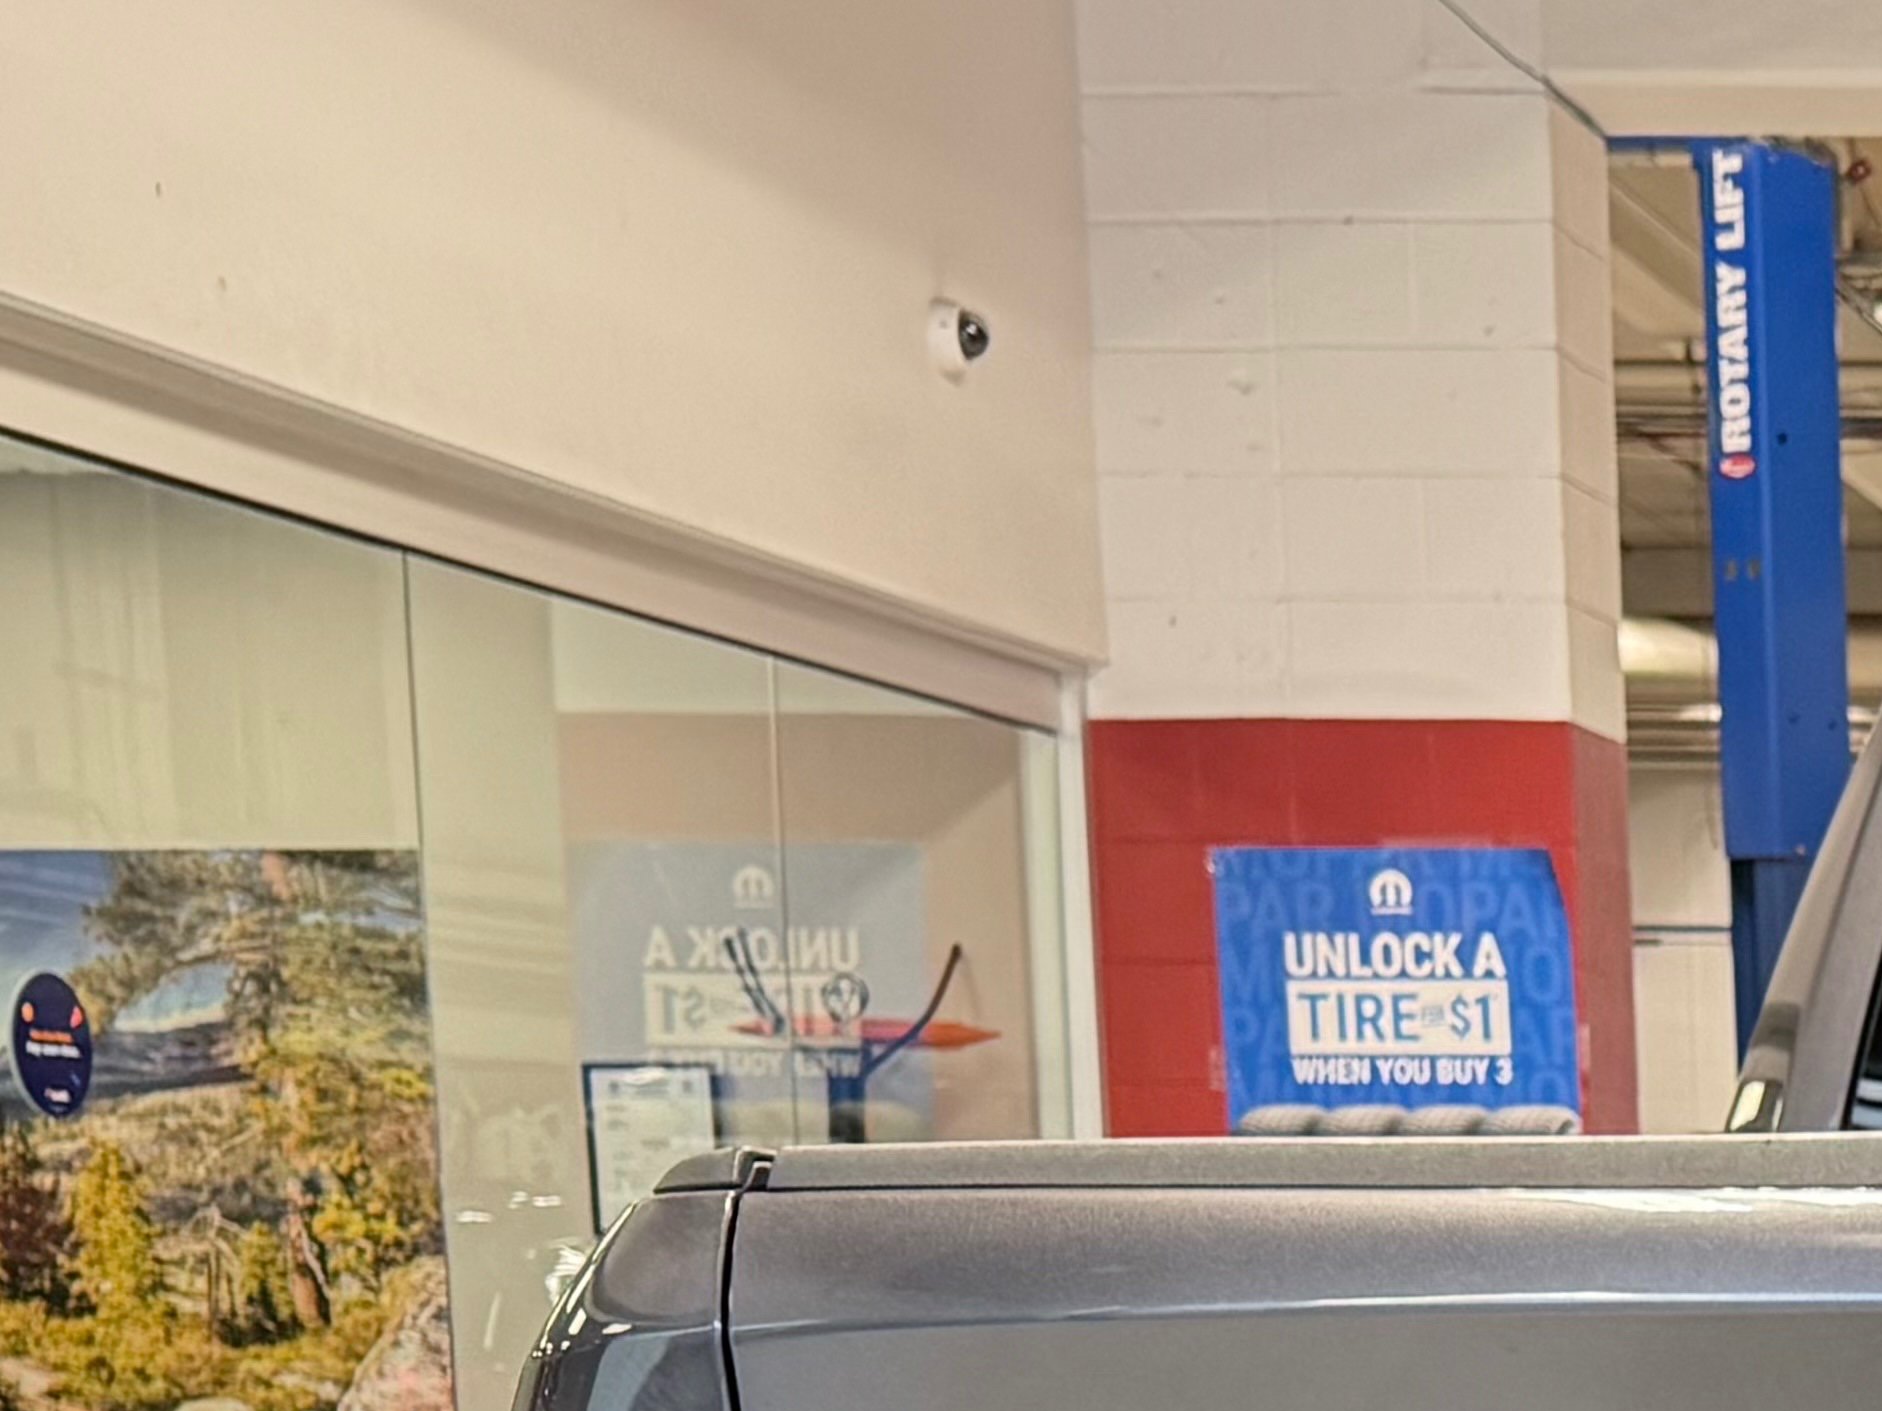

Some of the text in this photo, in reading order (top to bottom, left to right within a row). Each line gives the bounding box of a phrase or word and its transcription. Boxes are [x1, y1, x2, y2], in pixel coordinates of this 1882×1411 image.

[1712, 148, 1751, 453] ROTARY LIFT
[1284, 931, 1463, 978] UNLOCK
[1473, 931, 1506, 978] A
[1297, 993, 1422, 1043] TIRE
[1290, 1058, 1513, 1086] WHEN YOU BUY 3
